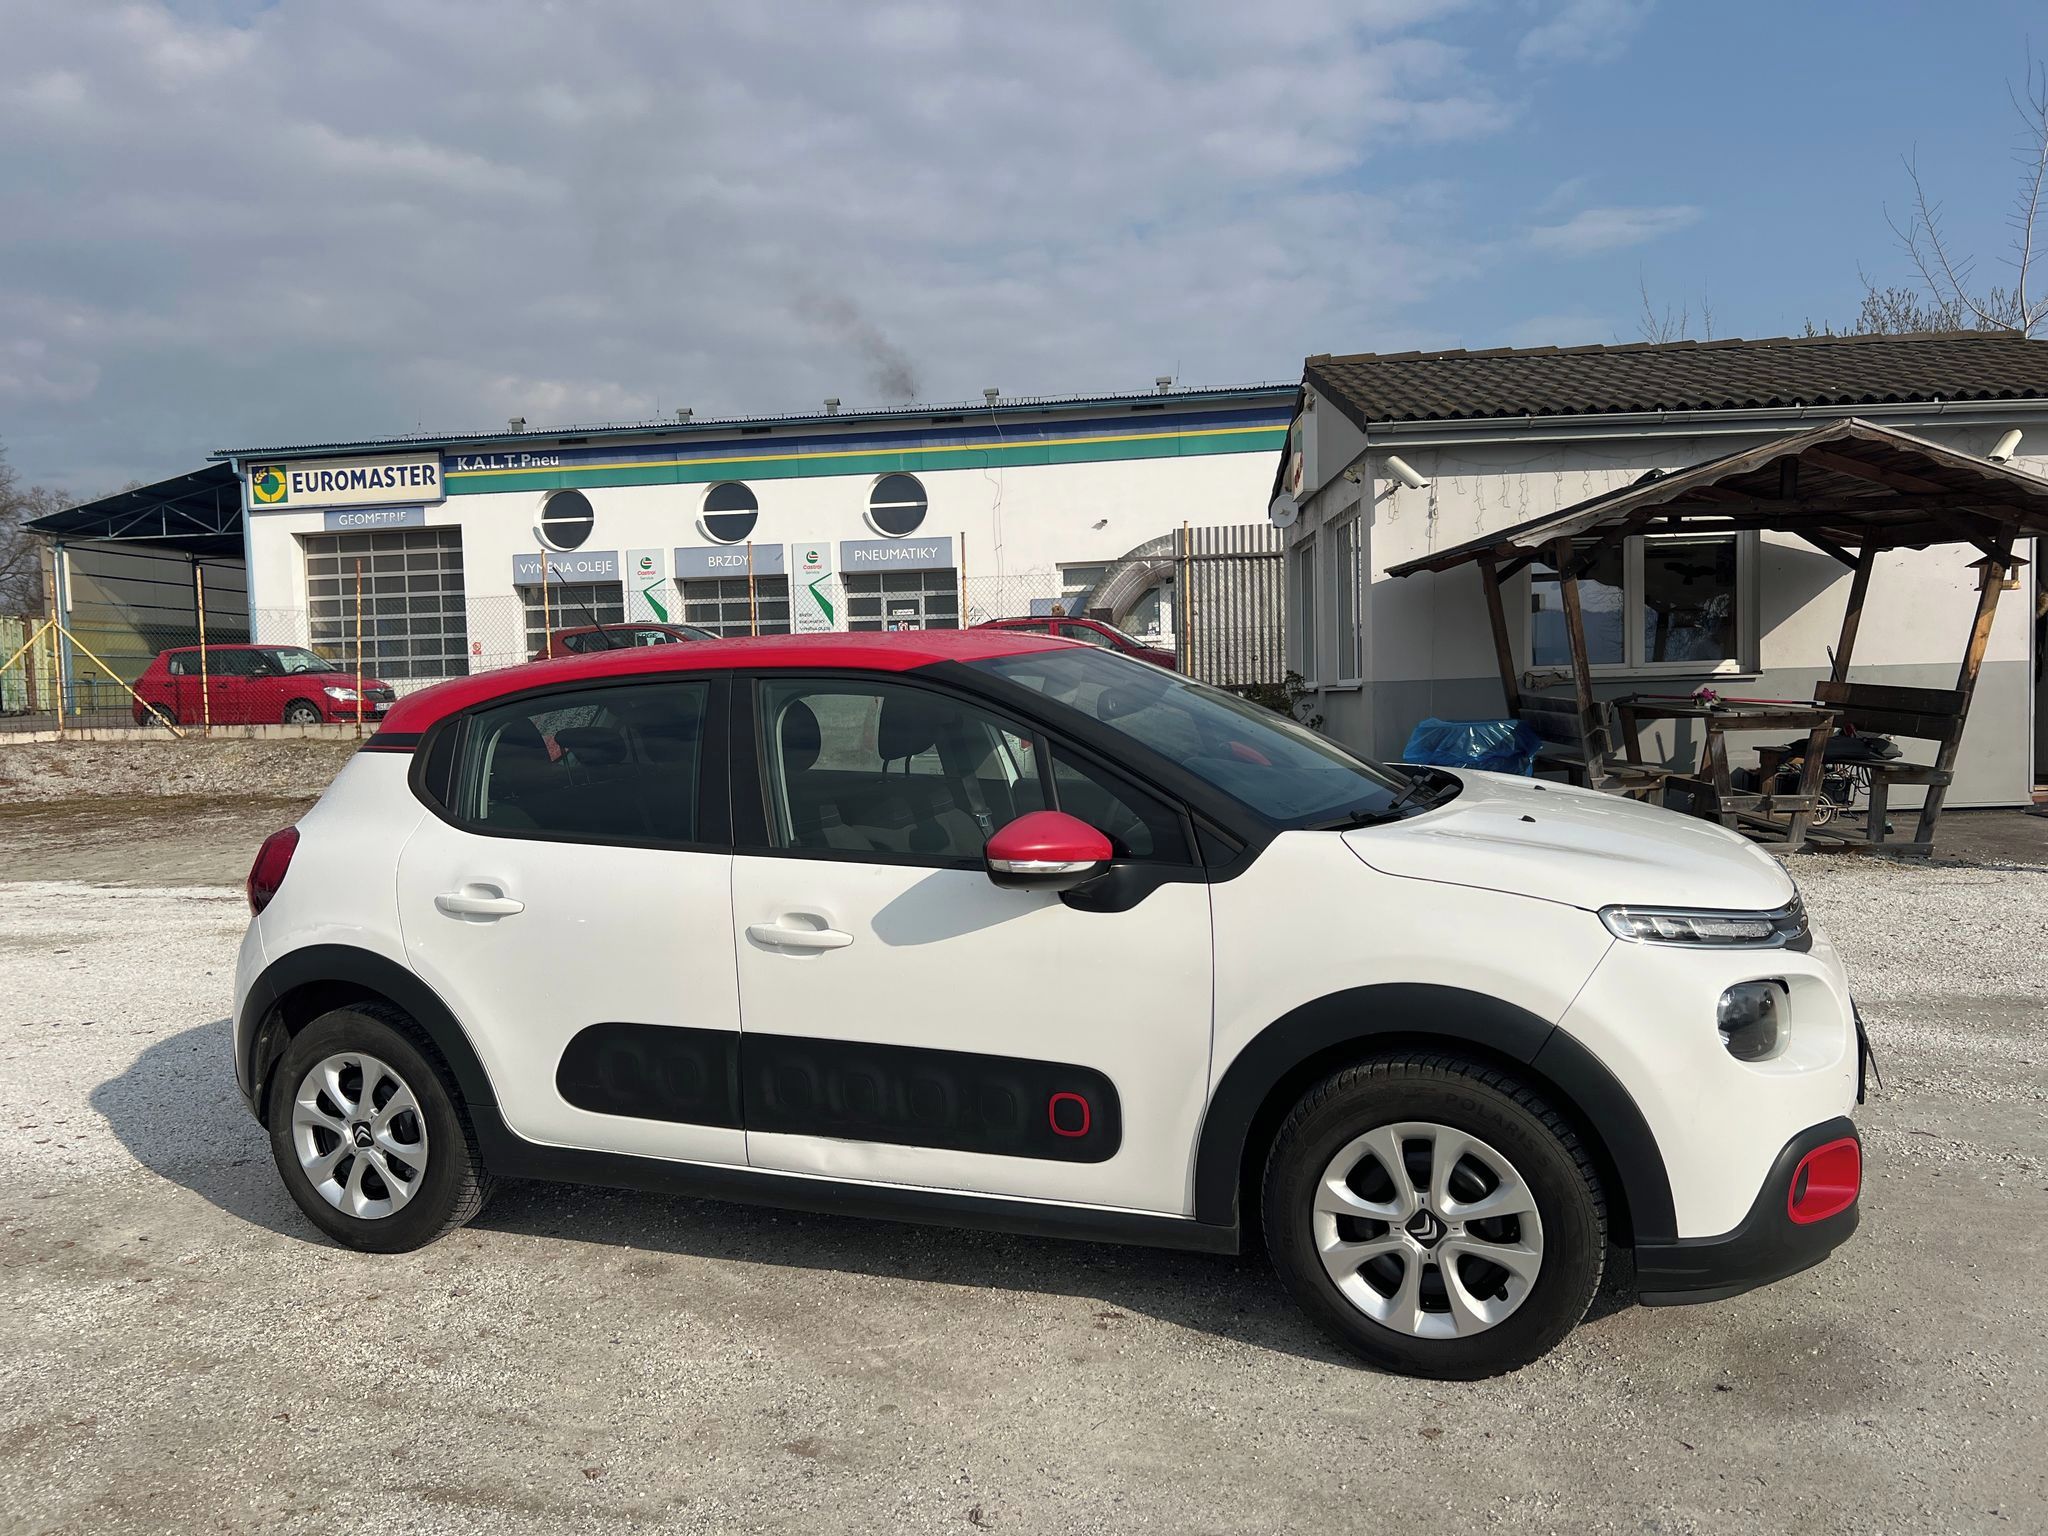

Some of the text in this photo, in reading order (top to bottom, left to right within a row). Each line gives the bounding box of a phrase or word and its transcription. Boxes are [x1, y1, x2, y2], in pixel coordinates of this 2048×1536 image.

[457, 453, 560, 471] K.A.L.T. Pneu
[292, 464, 437, 493] EUROMASTER
[338, 511, 407, 526] GEOMETRIE
[708, 554, 749, 567] BRZDY
[854, 546, 938, 561] PNEUMATIKY
[576, 560, 613, 575] OLEJE
